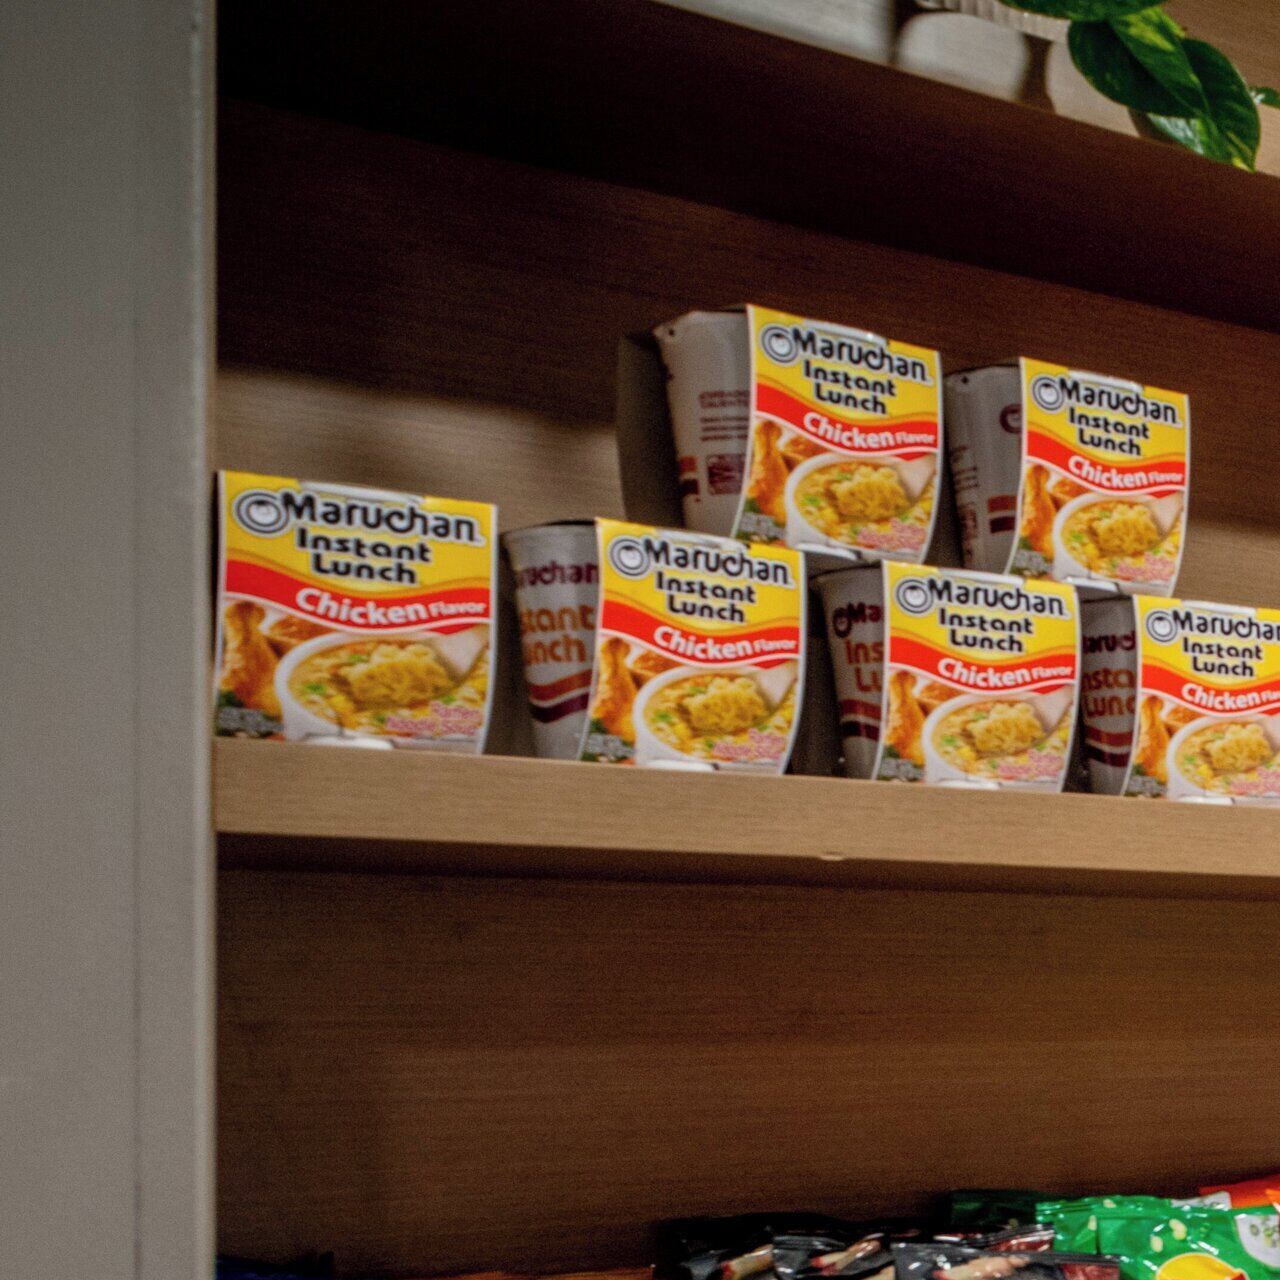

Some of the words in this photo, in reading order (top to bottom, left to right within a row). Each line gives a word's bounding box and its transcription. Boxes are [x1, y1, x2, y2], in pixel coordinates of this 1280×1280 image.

[792, 328, 927, 382] Maruchan
[804, 360, 896, 396] Instant
[815, 383, 886, 414] Lunch
[1059, 378, 1177, 424] Maruchan
[803, 412, 895, 448] Chicken
[1069, 408, 1149, 440] Instant
[1078, 428, 1141, 456] Lunch
[1068, 456, 1147, 487] Chicken
[280, 492, 475, 542] Maruchan
[297, 527, 431, 562] Instant
[312, 553, 416, 584] Lunch
[644, 539, 788, 584] Maruchan
[656, 572, 756, 602] Instant
[928, 578, 1065, 615] Maruchan
[296, 588, 427, 625] Chicken
[428, 602, 487, 617] Flavor
[668, 595, 744, 622] Lunch
[939, 608, 1032, 634] Instant
[654, 626, 750, 659] Chicken
[751, 640, 797, 652] Flavor
[950, 630, 1023, 651] Lunch
[1183, 637, 1262, 660] Instant
[938, 658, 1031, 686] Chicken
[1192, 656, 1254, 677] Lunch
[1182, 683, 1261, 710] Chicken
